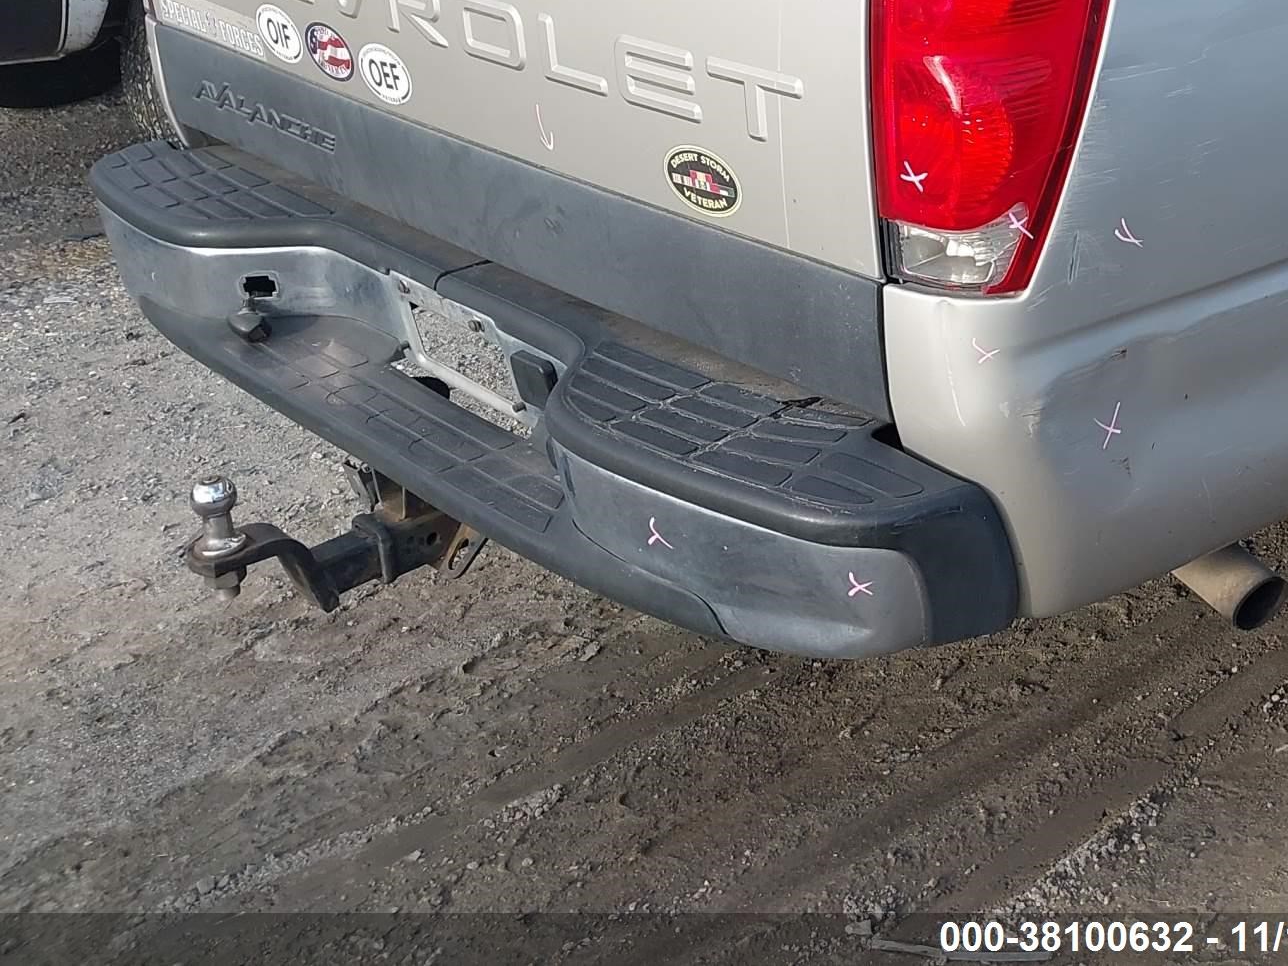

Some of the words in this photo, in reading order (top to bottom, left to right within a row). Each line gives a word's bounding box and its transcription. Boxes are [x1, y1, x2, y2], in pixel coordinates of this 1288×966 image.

[218, 19, 264, 56] FORCES
[266, 18, 291, 49] OIF
[369, 59, 400, 91] OEF
[192, 80, 336, 154] AVALANCHE
[670, 153, 698, 168] DESERT
[700, 155, 730, 182] STORM
[683, 187, 728, 210] VETERAN
